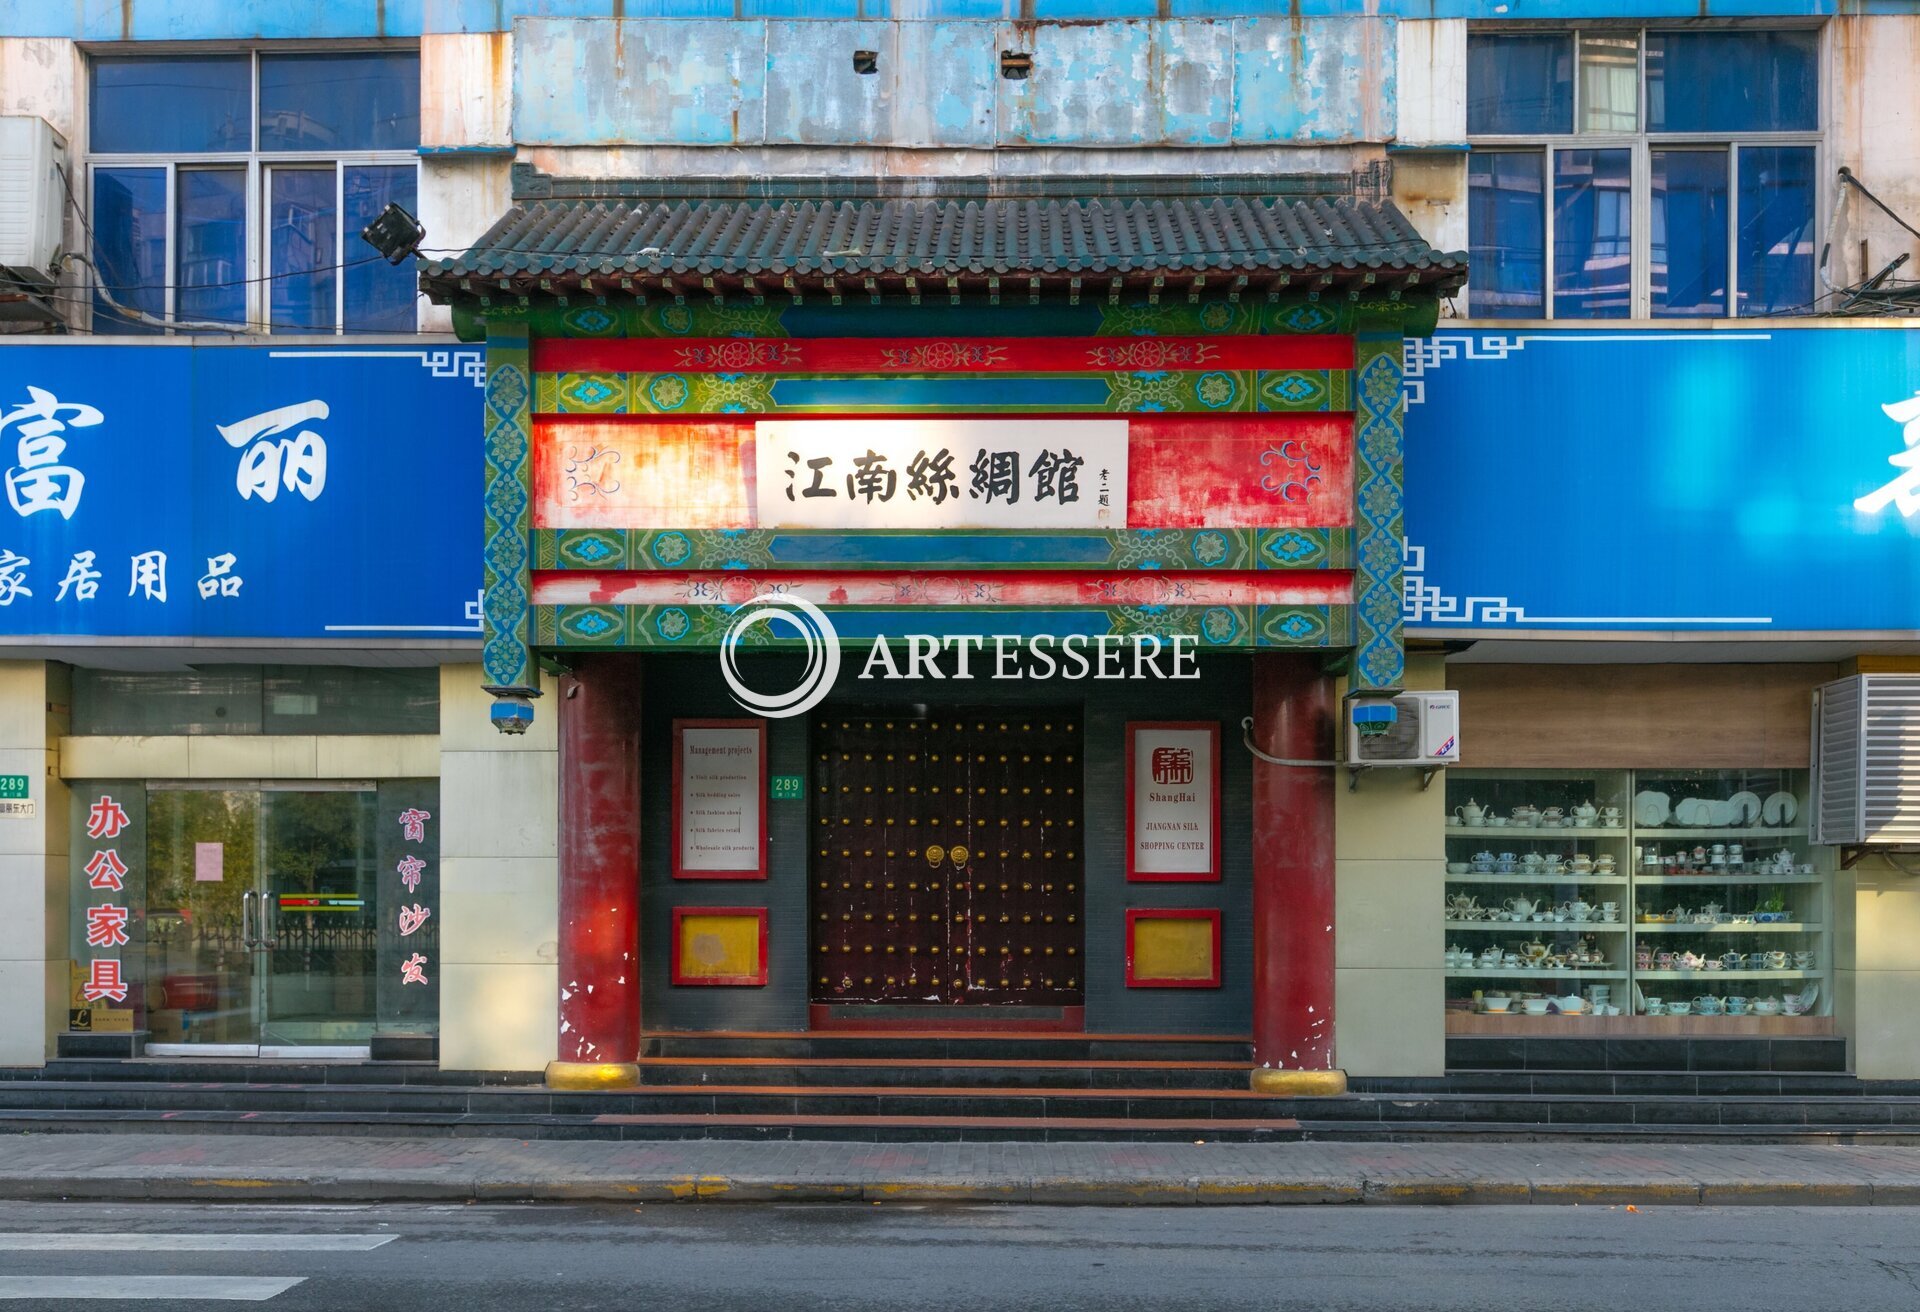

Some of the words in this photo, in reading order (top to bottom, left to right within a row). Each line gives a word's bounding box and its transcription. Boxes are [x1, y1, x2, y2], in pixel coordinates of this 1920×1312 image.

[0, 386, 330, 520] 富丽
[784, 448, 1085, 505] 江南絲綢館
[0, 549, 244, 606] 家居用品
[690, 745, 726, 755] Management
[728, 745, 752, 757] projects
[0, 777, 24, 791] 289
[720, 774, 747, 782] production
[776, 778, 799, 791] 289
[1149, 792, 1196, 804] ShangHai
[1146, 822, 1181, 831] JIANGNAN
[1140, 841, 1175, 850] SHOPPING
[1177, 841, 1205, 850] CENTER
[84, 795, 130, 1002] 办公家具
[397, 808, 431, 986] 窗帘沙发
